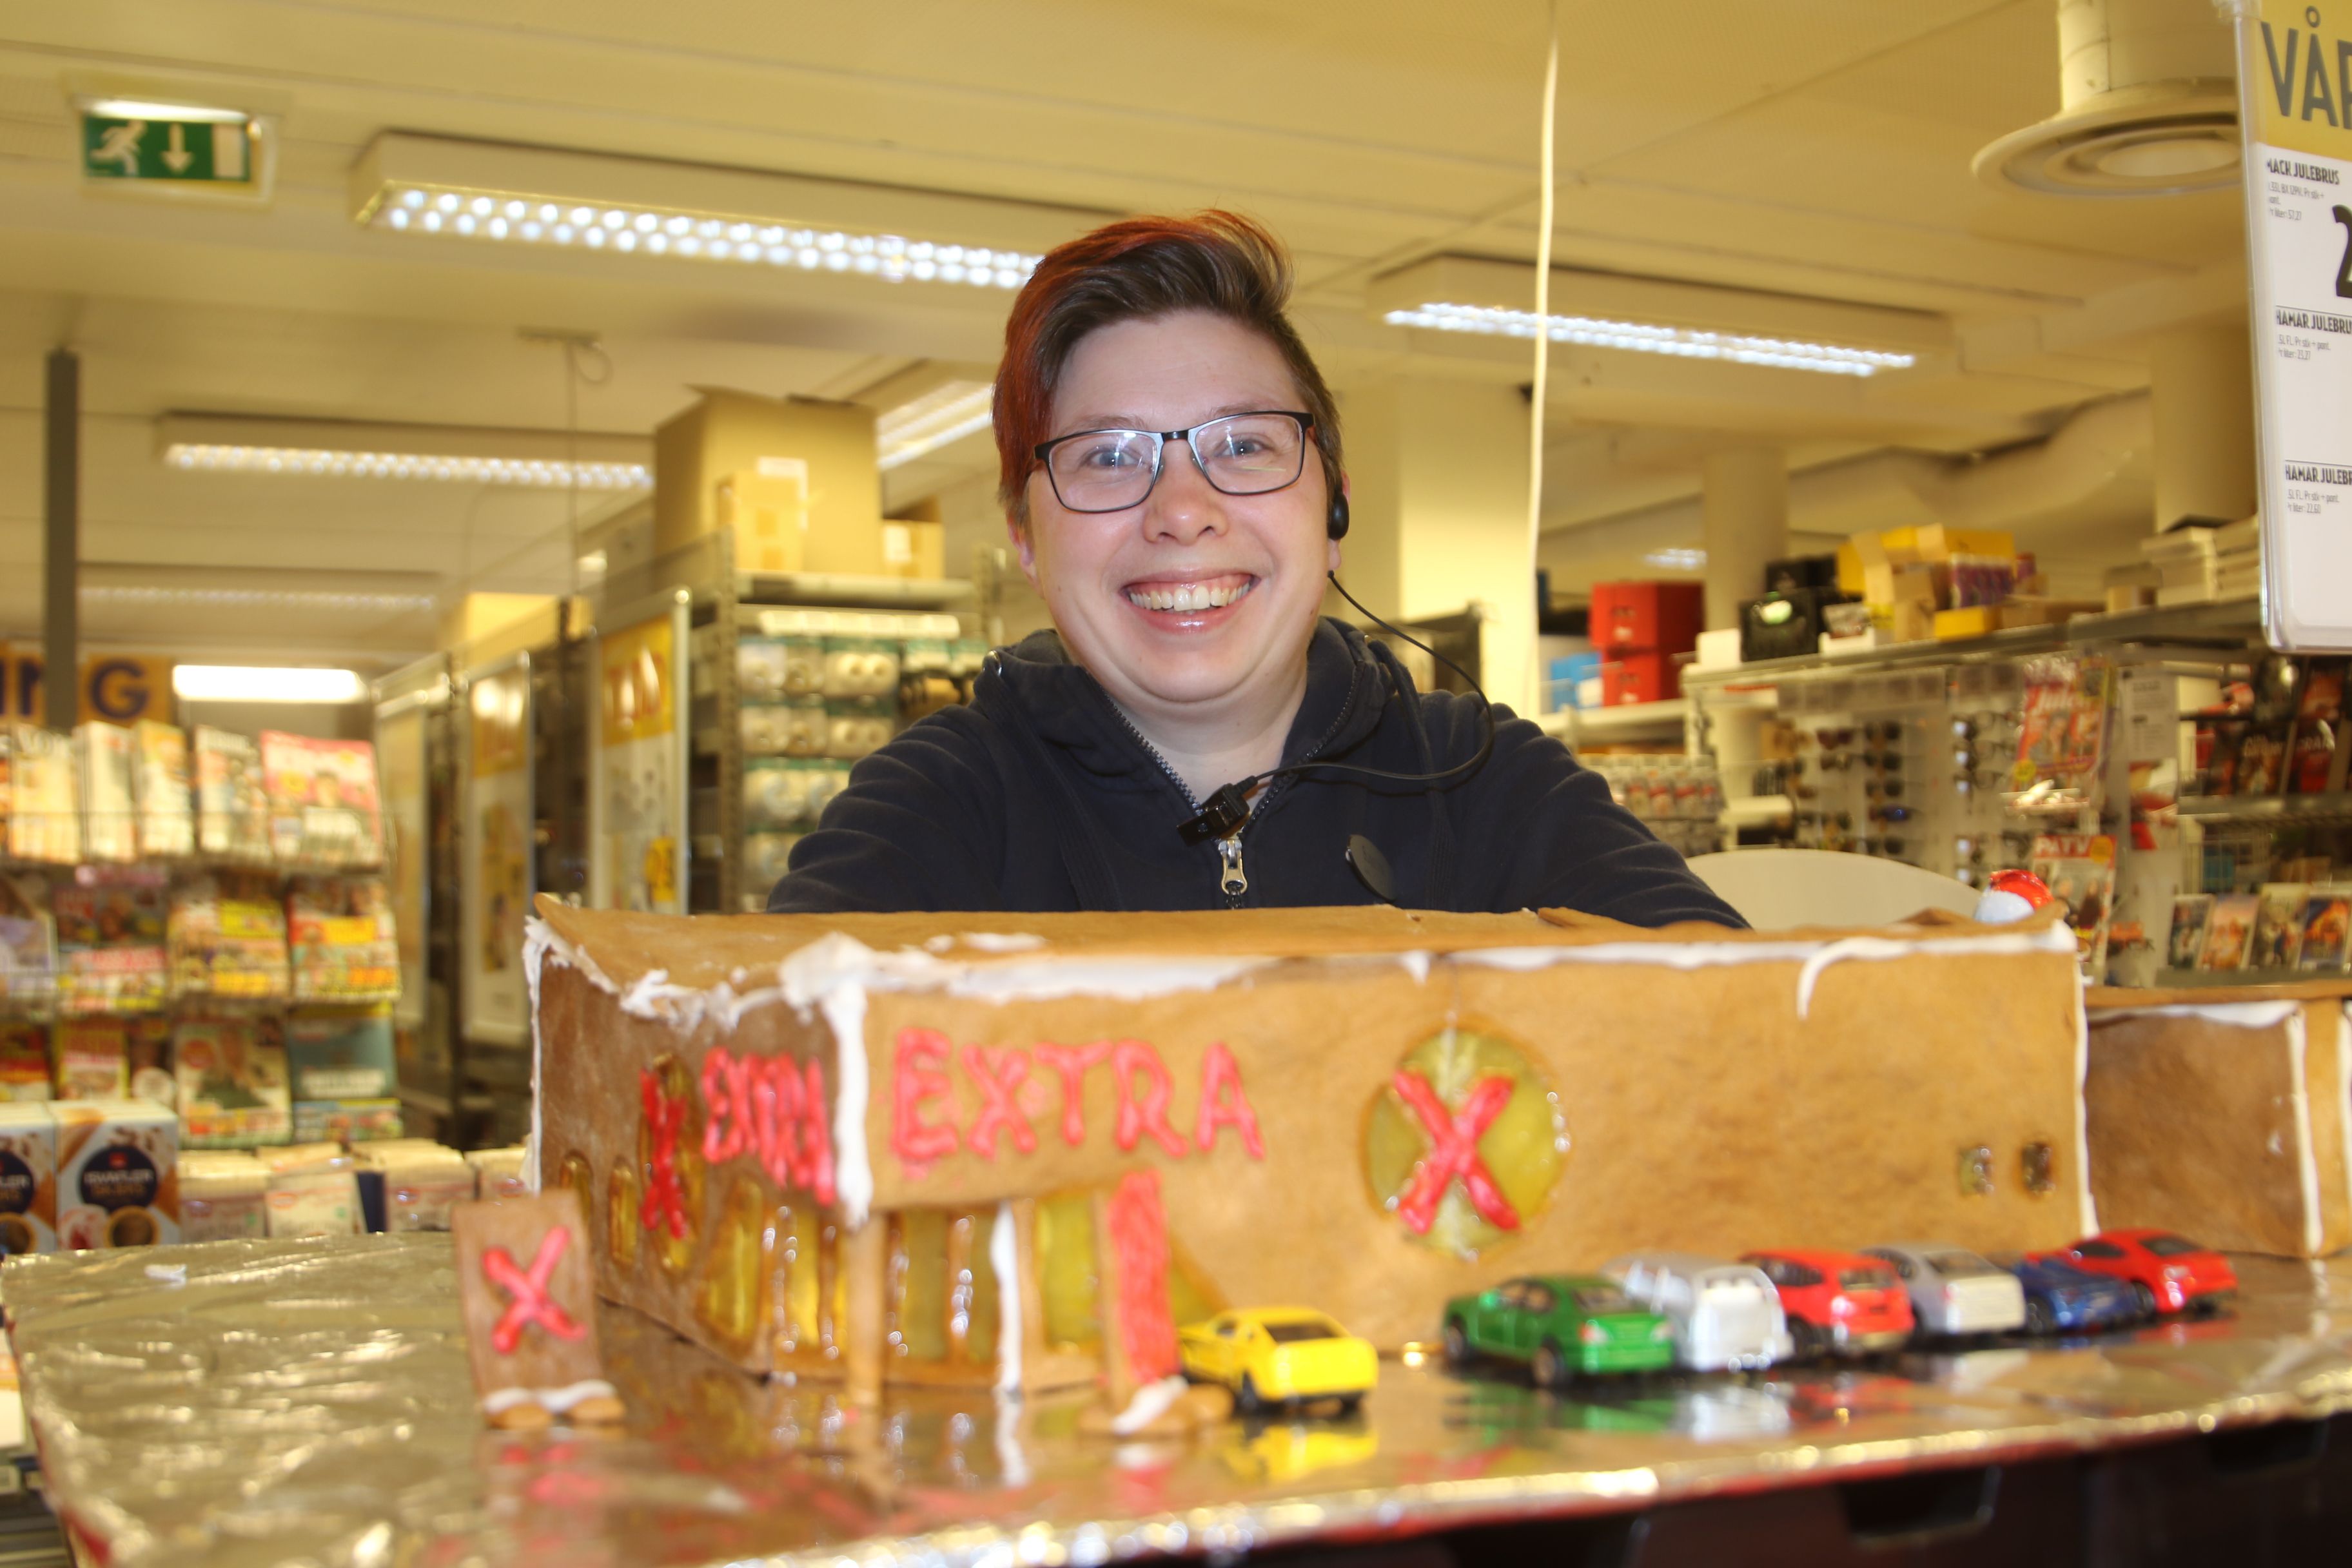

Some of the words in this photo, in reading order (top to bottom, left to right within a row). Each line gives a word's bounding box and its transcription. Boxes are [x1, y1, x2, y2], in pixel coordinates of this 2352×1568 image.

[2293, 162, 2340, 186] JULEBRUS
[2286, 464, 2319, 482] HAMAR
[890, 1026, 1265, 1170] EXTRA
